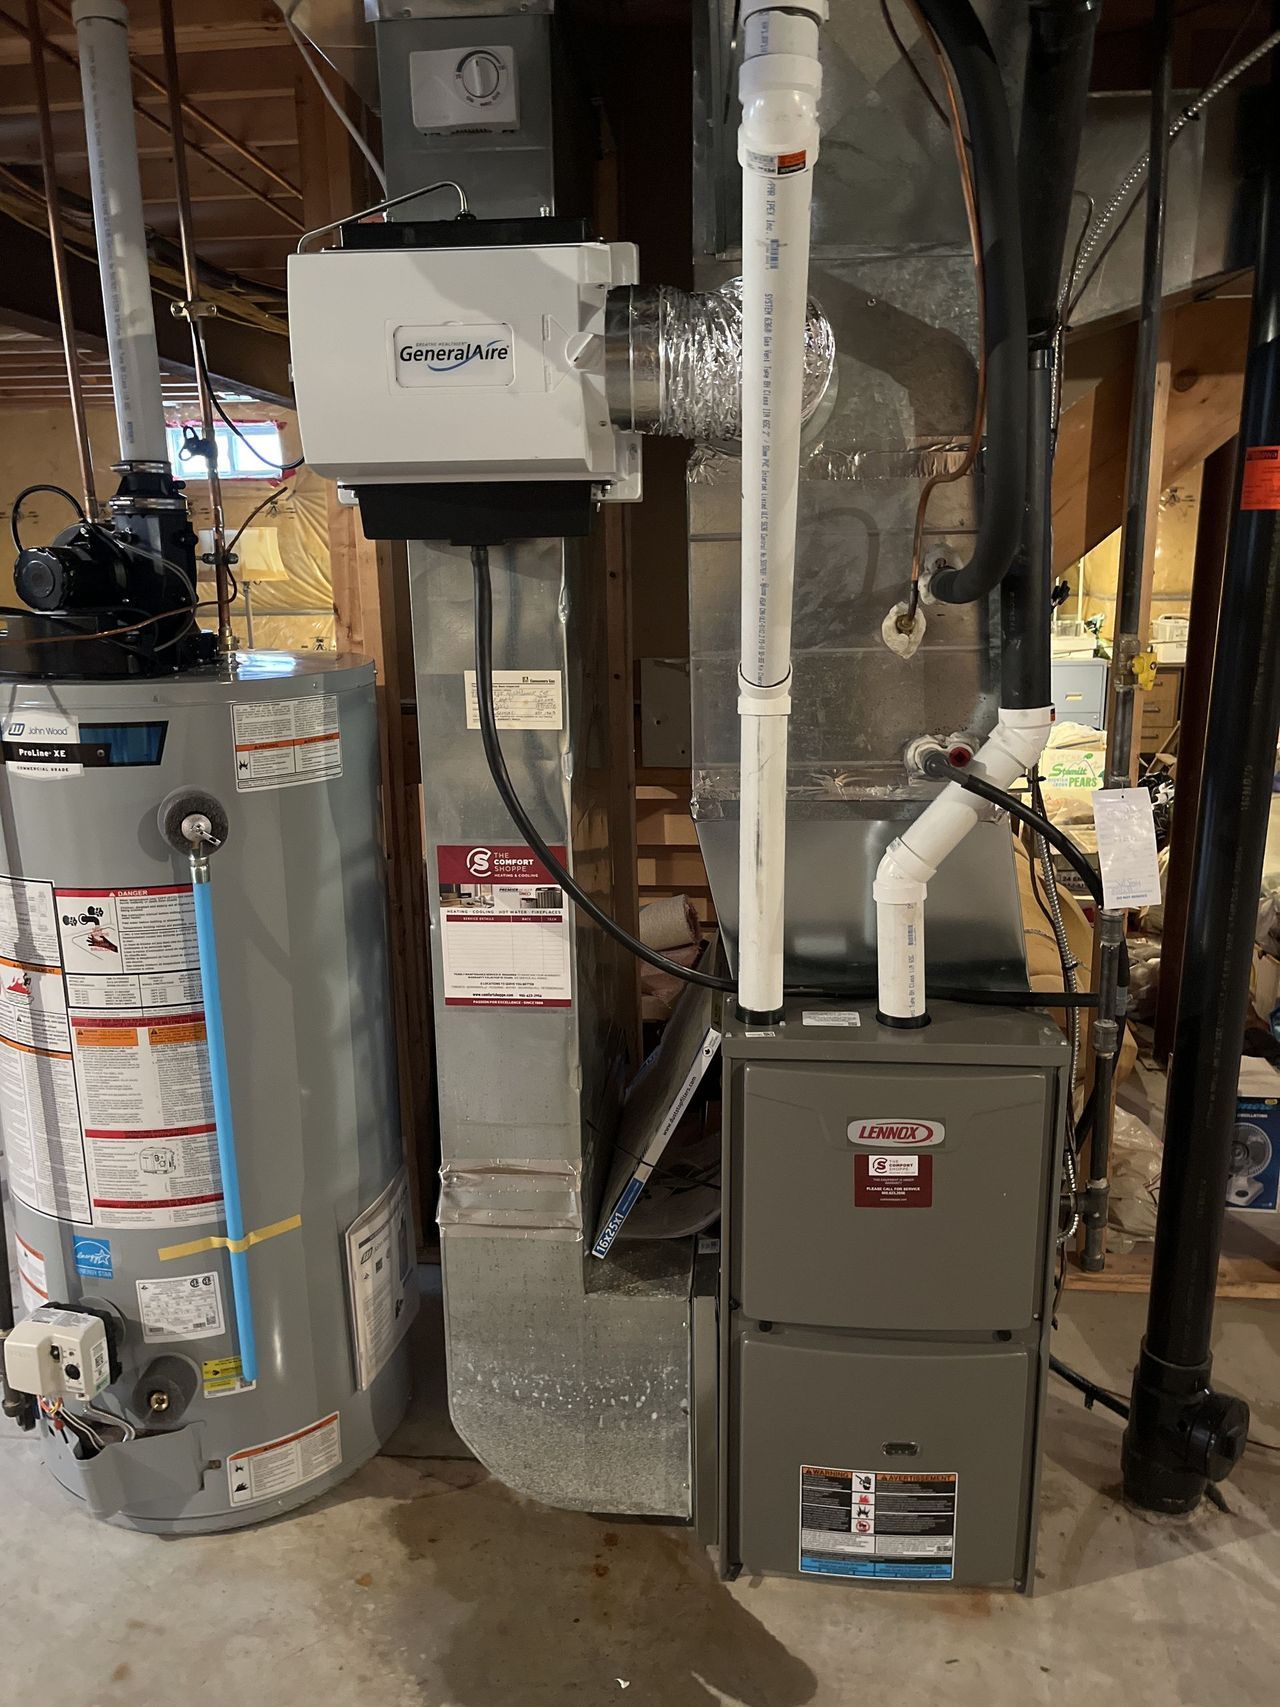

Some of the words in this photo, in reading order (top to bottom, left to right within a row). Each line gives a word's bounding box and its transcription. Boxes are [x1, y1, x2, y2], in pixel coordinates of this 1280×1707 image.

[766, 200, 776, 215] IPEX
[765, 219, 775, 234] Inc.
[764, 293, 774, 315] SYSTEM
[763, 336, 773, 347] Gas
[763, 349, 772, 362] Vent
[762, 366, 772, 379] Type
[762, 389, 772, 406] Class
[28, 727, 45, 735] John
[46, 727, 68, 736] Wood
[53, 749, 66, 757] XE
[1068, 777, 1097, 787] PEARS
[858, 1125, 920, 1140] LENNOX
[596, 1211, 625, 1254] 16x25x1
[812, 1469, 850, 1478] WARNING
[888, 1474, 951, 1482] AVERTISSEMENT
